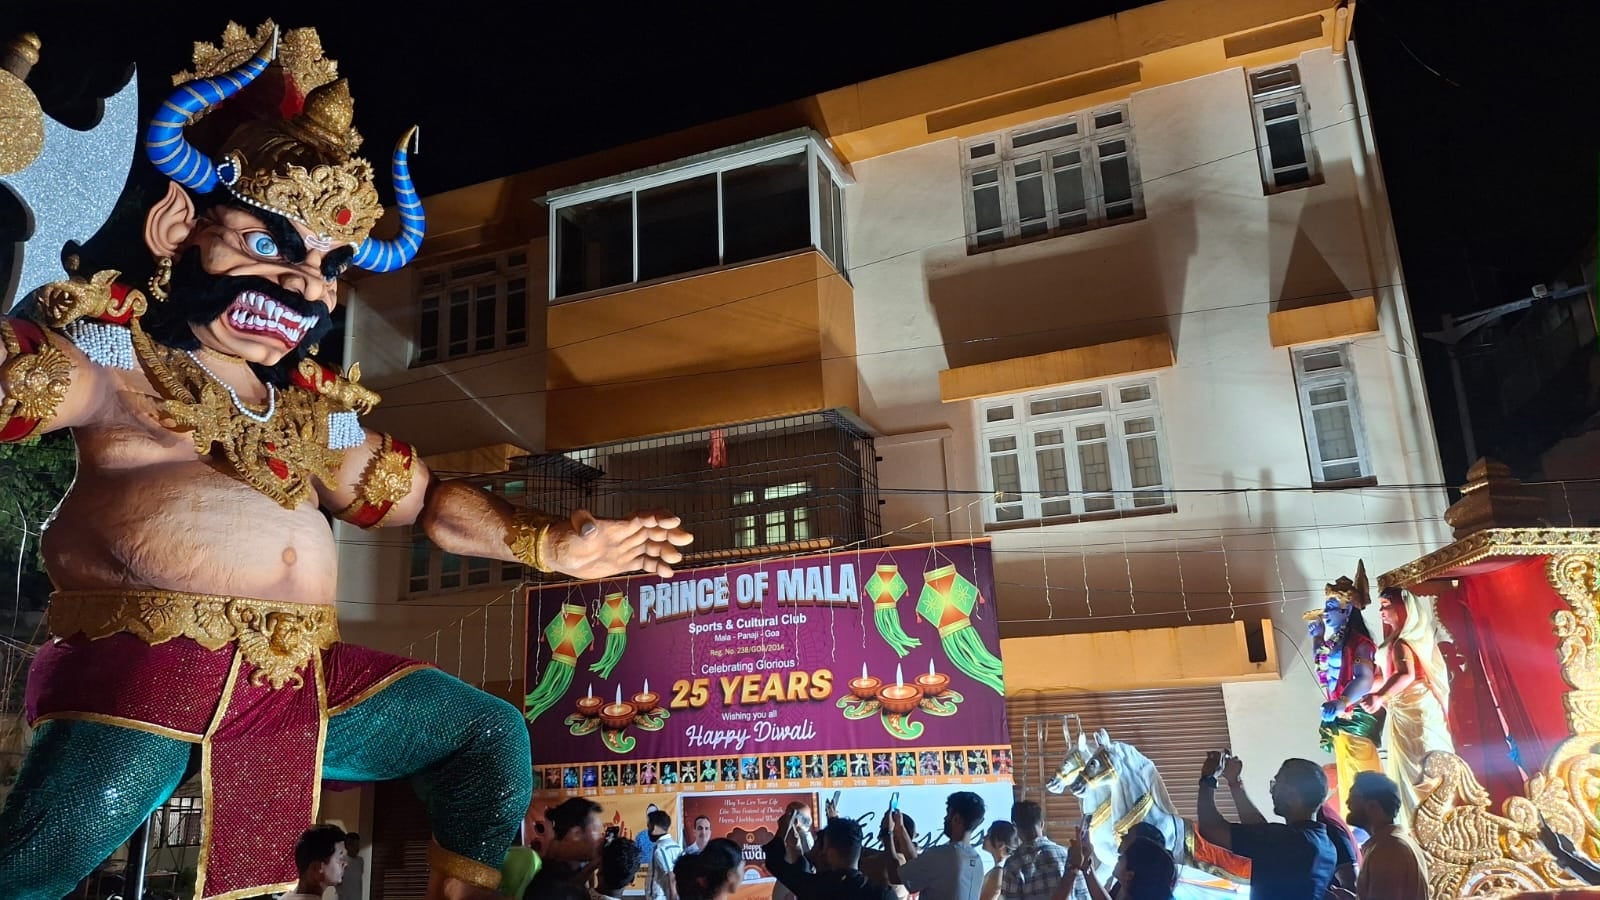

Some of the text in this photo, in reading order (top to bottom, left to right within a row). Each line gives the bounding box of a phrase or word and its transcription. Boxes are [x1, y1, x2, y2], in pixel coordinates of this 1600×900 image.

[640, 563, 859, 627] PRINCE OF MALA
[688, 614, 807, 635] Sports & Cultural Club
[714, 633, 732, 642] Mala
[737, 631, 759, 641] Panaji
[765, 630, 780, 638] Goa
[710, 649, 723, 657] Reg.
[701, 658, 796, 675] Celebrating Glorious
[670, 669, 834, 709] 25 YEARS
[722, 710, 778, 722] Wishing you all
[686, 719, 817, 751] Happy Diwali
